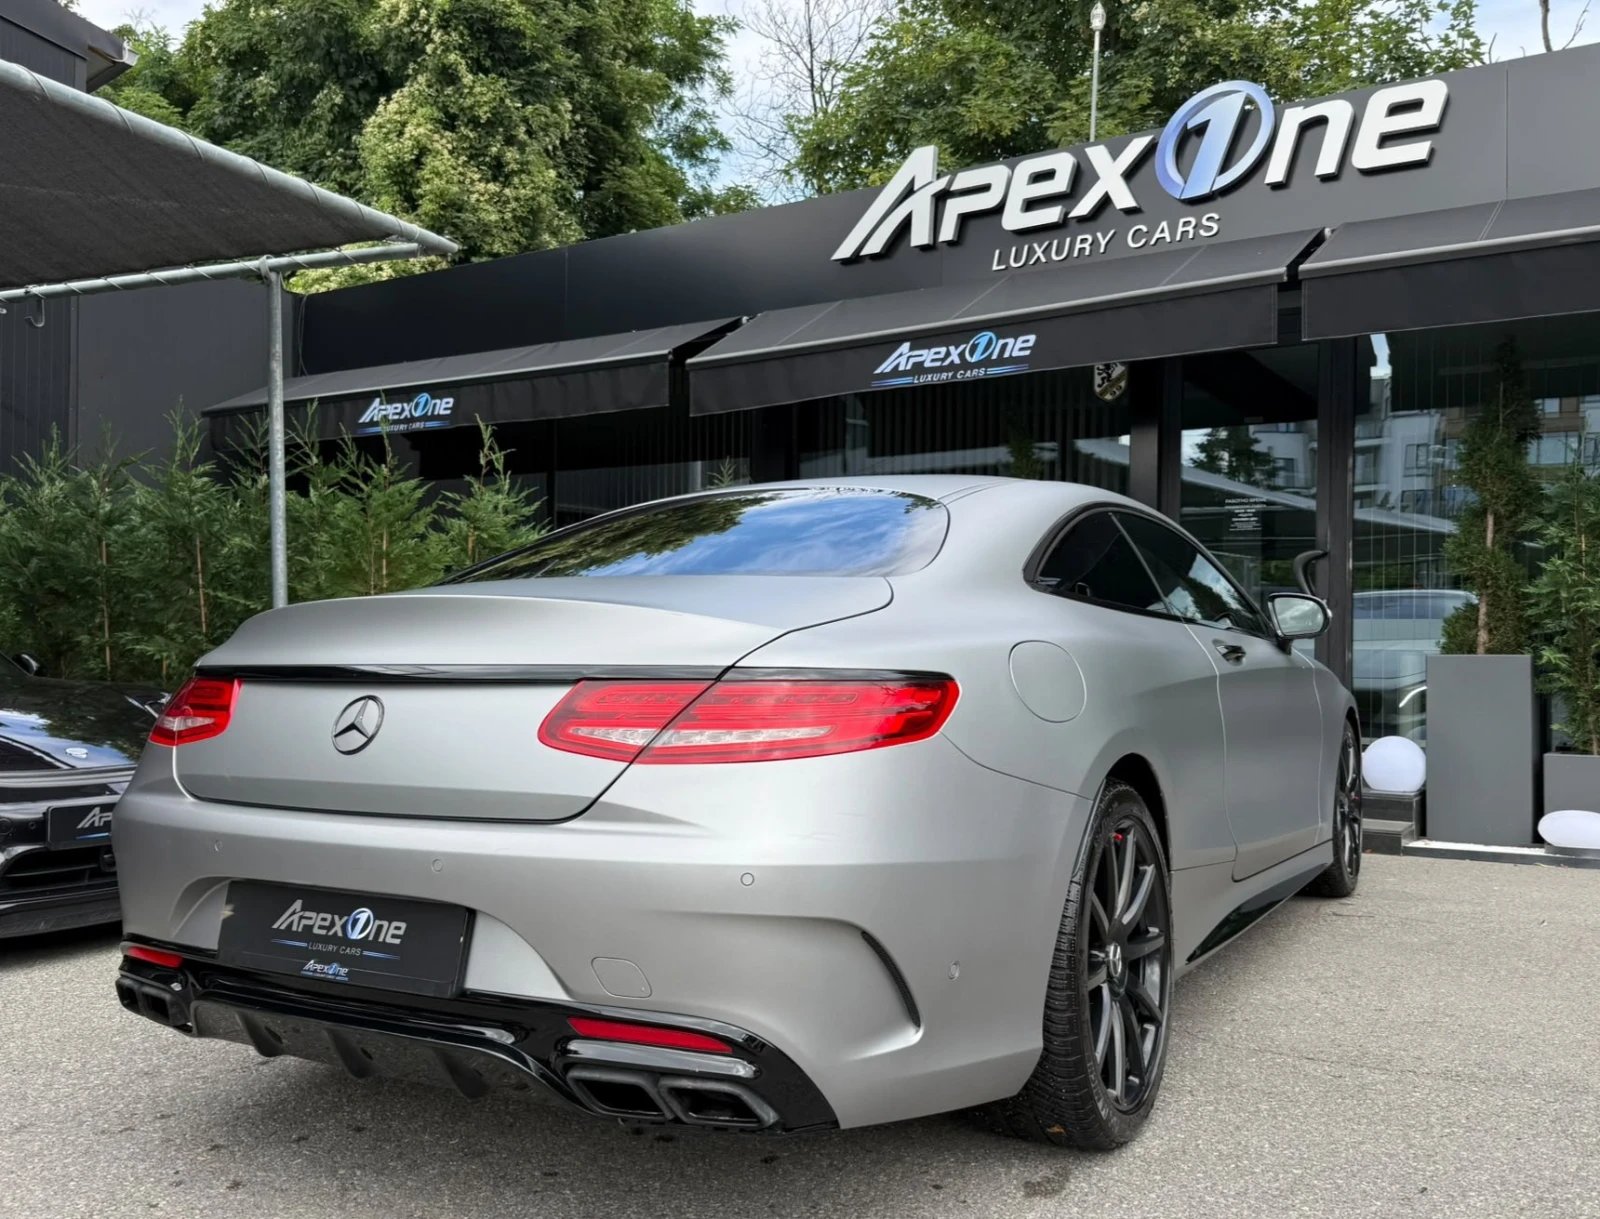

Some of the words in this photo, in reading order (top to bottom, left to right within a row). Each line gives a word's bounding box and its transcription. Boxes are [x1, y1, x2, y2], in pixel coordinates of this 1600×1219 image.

[992, 229, 1116, 271] LUXURY
[1126, 212, 1220, 249] CARS
[913, 371, 953, 384] LUXURY
[956, 368, 986, 380] CARS
[382, 424, 408, 432] UXURY
[308, 942, 338, 954] LUXURY
[339, 945, 362, 956] CARS
